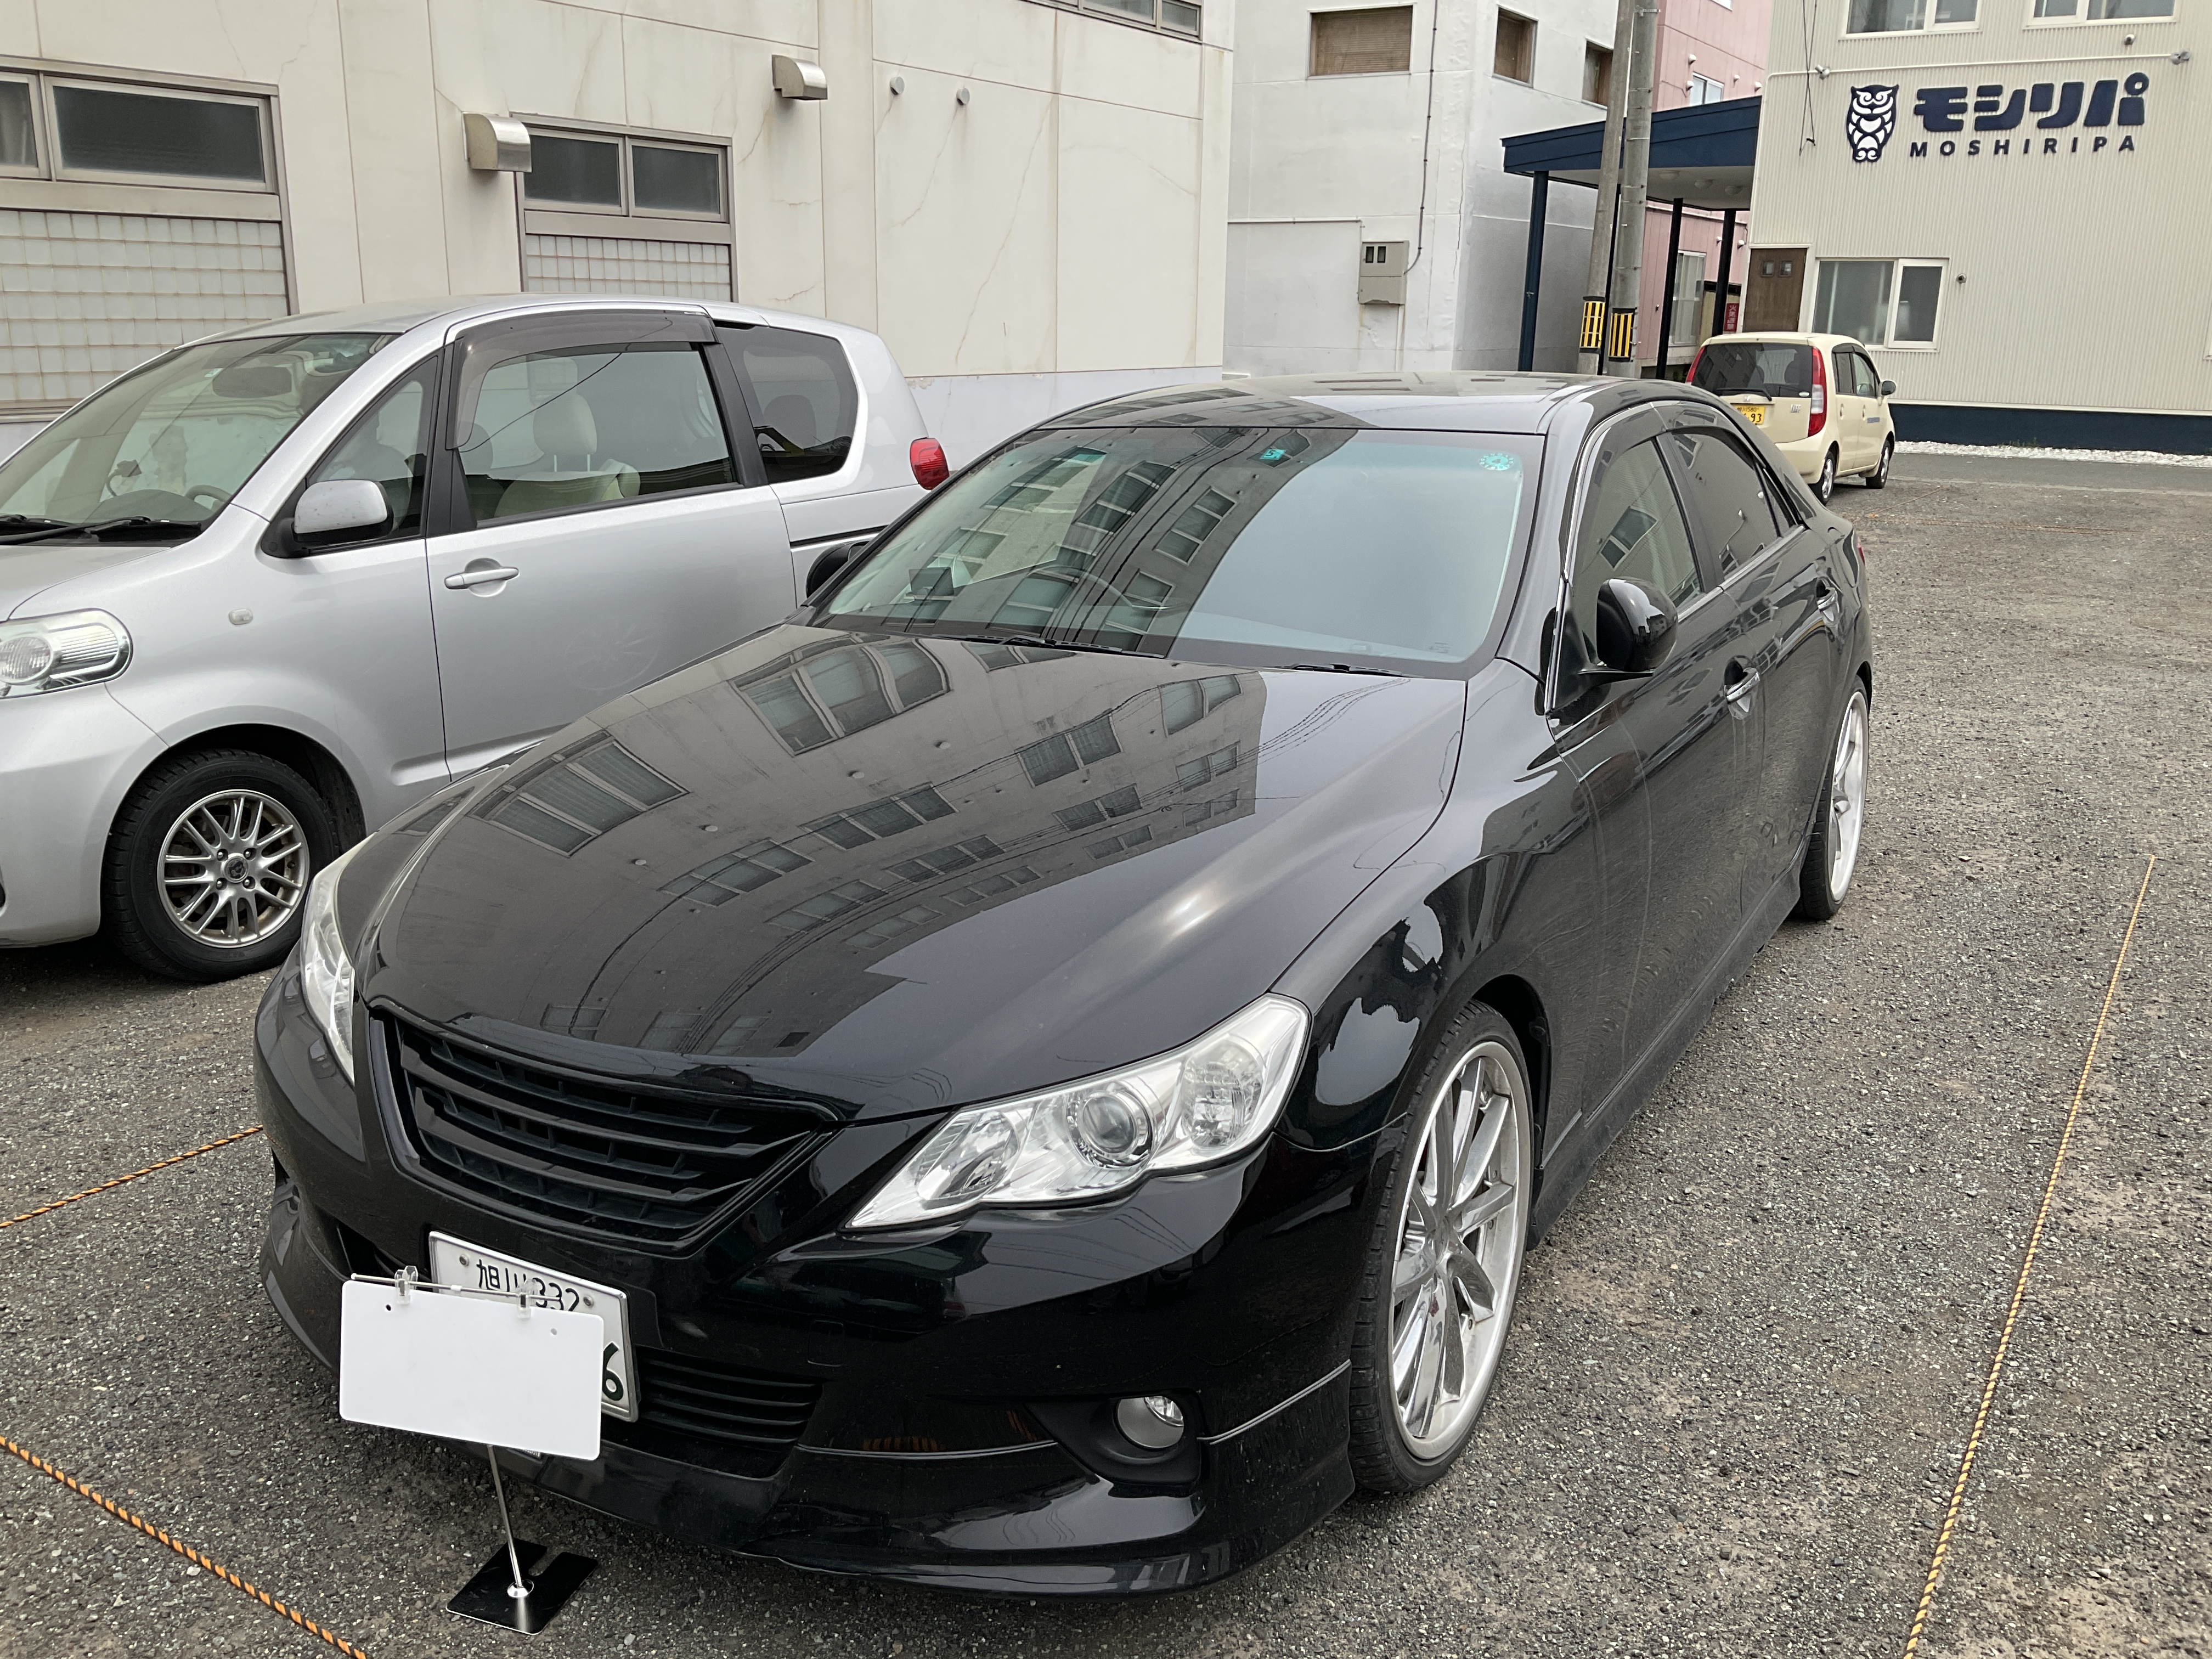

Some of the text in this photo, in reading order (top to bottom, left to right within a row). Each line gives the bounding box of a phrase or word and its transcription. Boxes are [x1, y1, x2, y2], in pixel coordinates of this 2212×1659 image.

[1914, 72, 2149, 132] モシリパ
[1910, 135, 2135, 157] MOSHIRIPA
